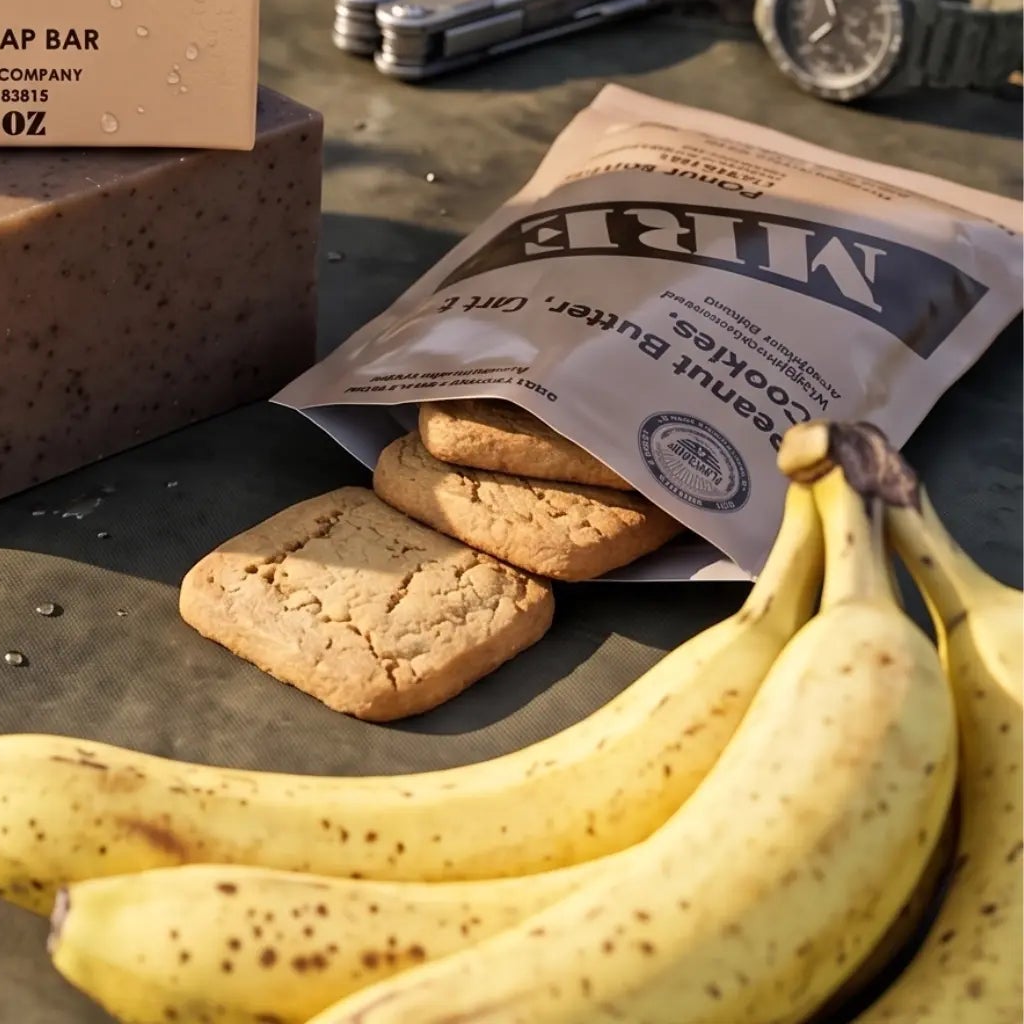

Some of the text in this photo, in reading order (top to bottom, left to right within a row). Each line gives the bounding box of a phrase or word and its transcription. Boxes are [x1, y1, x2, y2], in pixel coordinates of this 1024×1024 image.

[45, 29, 99, 50] BAR
[1, 89, 49, 103] 83815
[1, 110, 47, 136] OZ
[522, 206, 887, 314] MRE
[545, 295, 672, 361] Butter,
